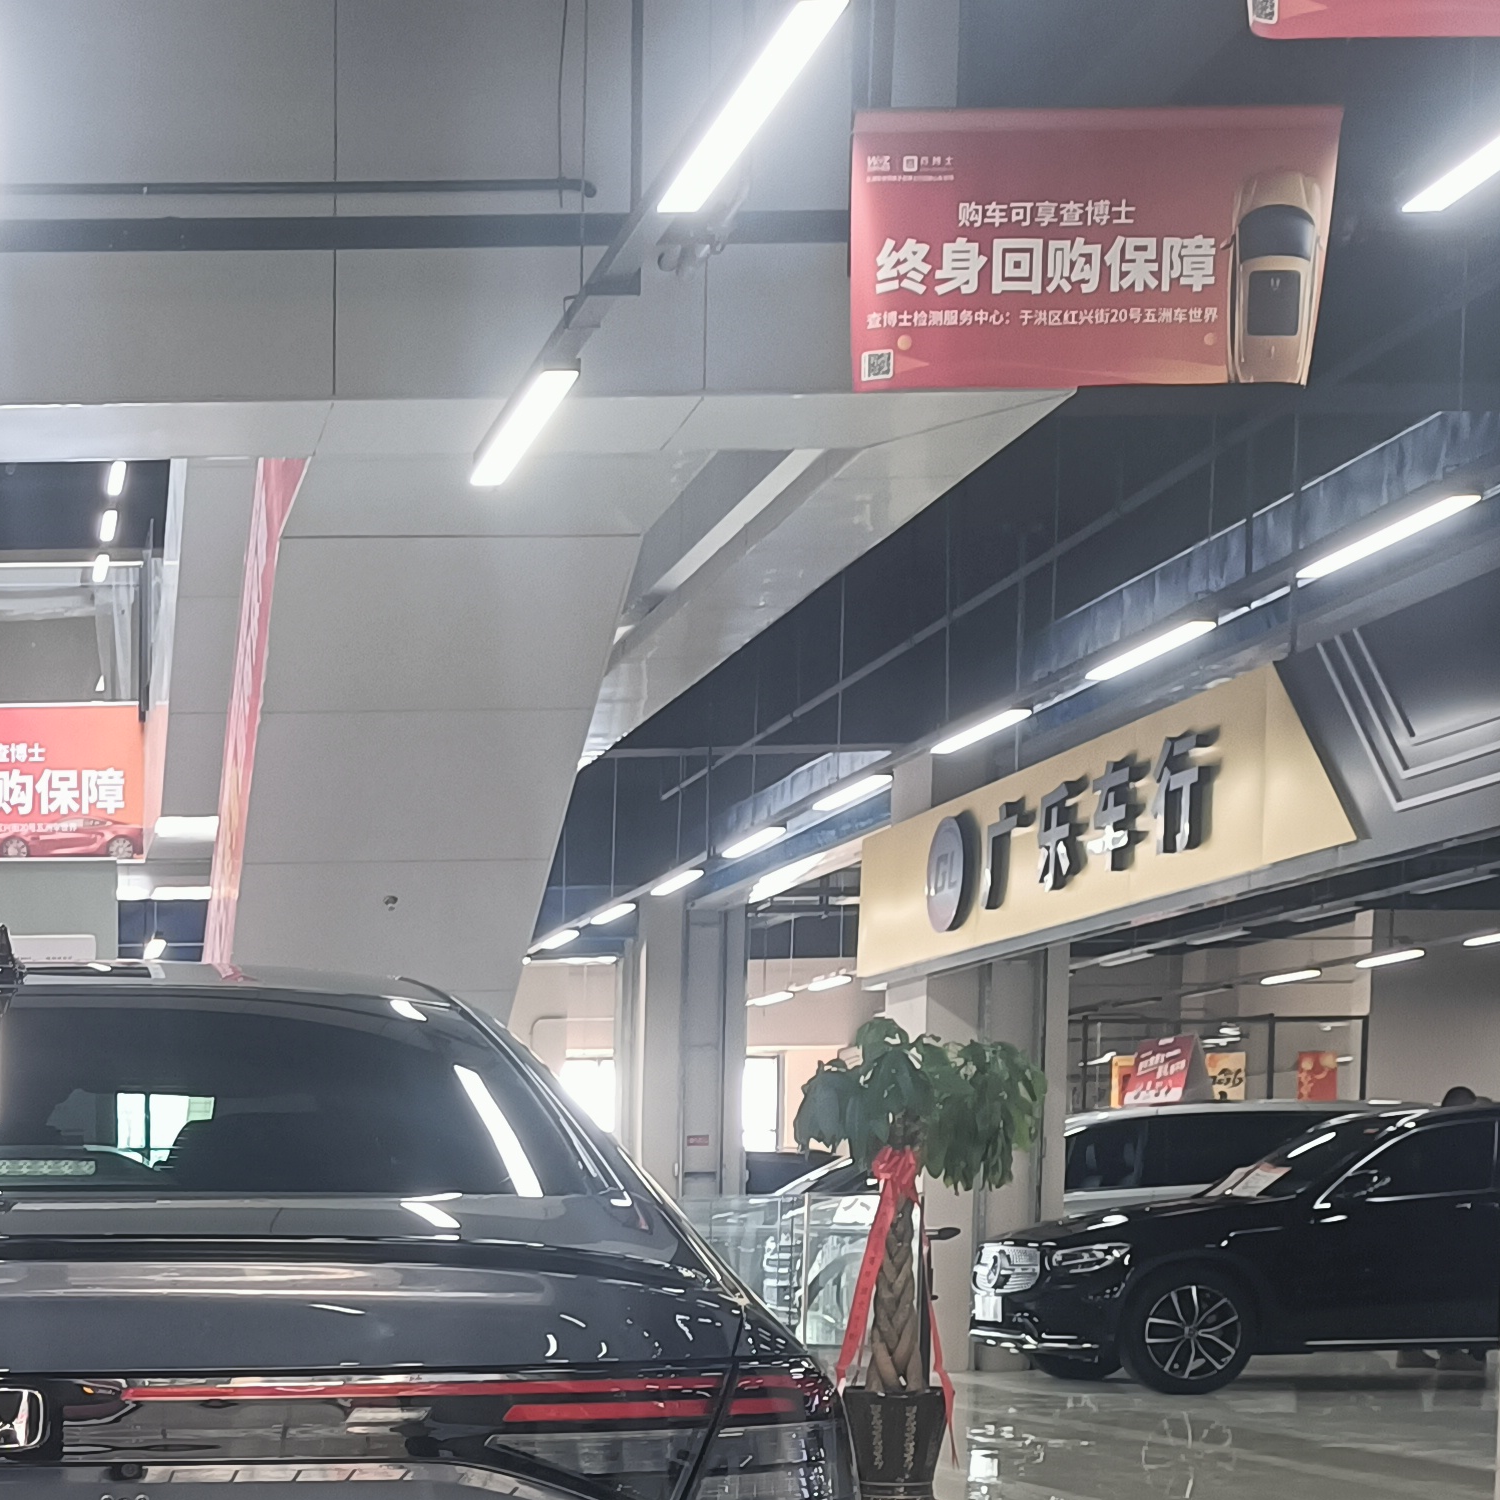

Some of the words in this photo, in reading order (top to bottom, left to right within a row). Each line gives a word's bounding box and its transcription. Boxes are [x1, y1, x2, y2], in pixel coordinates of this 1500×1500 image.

[957, 199, 1136, 228] 购车可享查博士
[874, 234, 1218, 297] 终身回购保障
[981, 731, 1213, 910] 广乐车行
